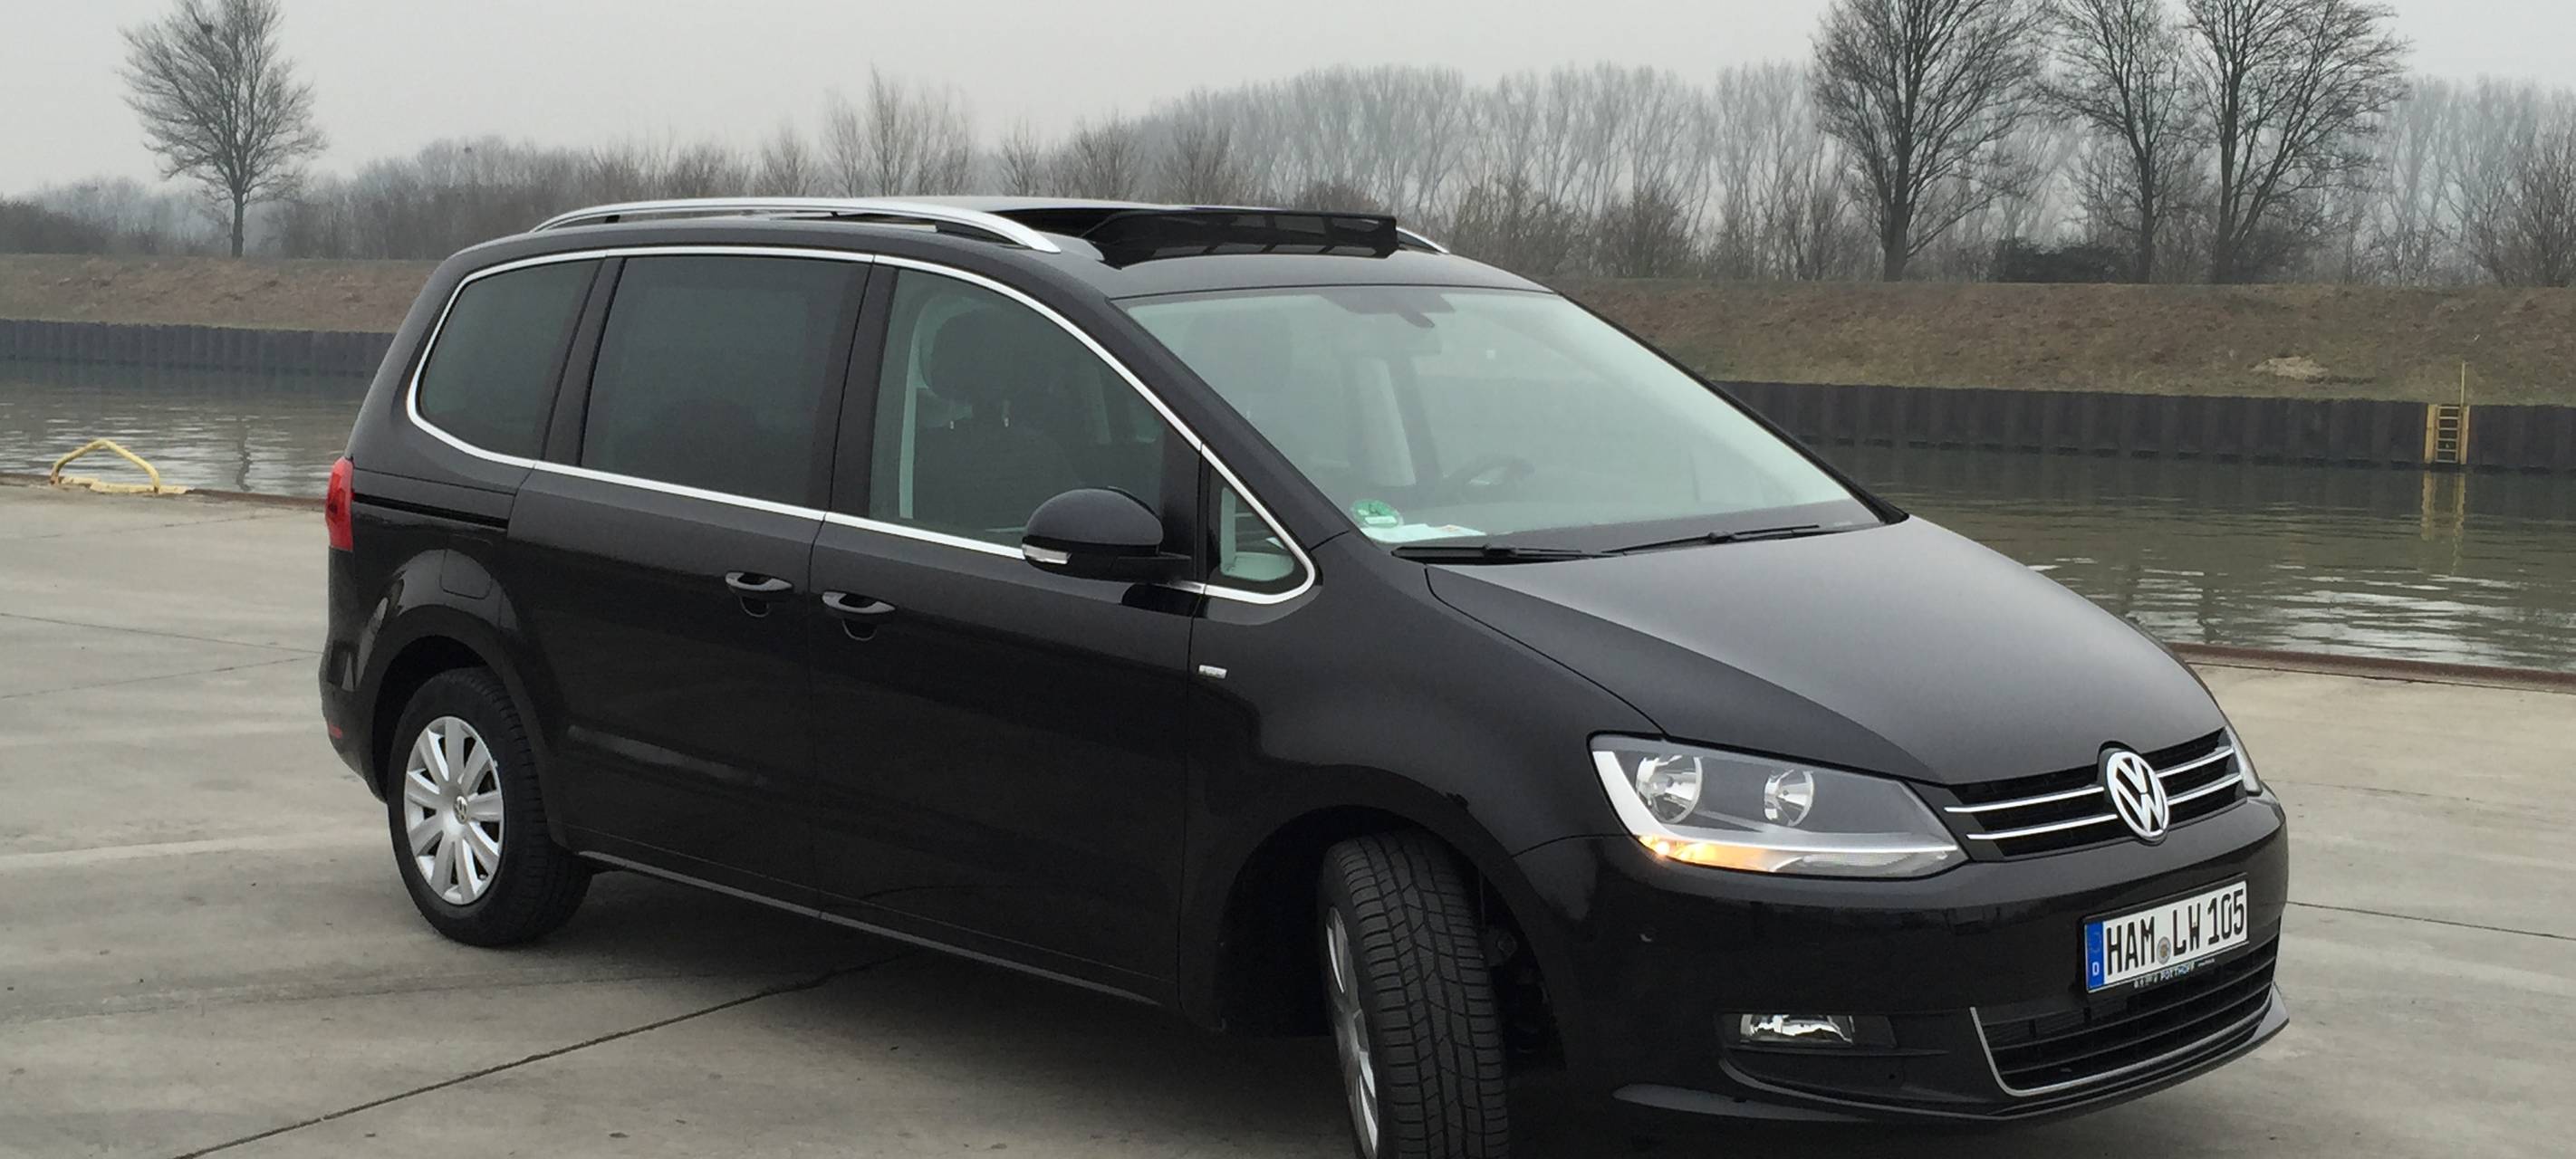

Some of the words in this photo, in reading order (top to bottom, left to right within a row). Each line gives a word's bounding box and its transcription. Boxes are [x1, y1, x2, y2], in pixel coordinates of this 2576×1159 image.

[2109, 752, 2167, 837] VW
[2091, 962, 2100, 976] D
[2106, 915, 2156, 975] HAM
[2172, 903, 2201, 957] LW
[2207, 888, 2244, 945] 105
